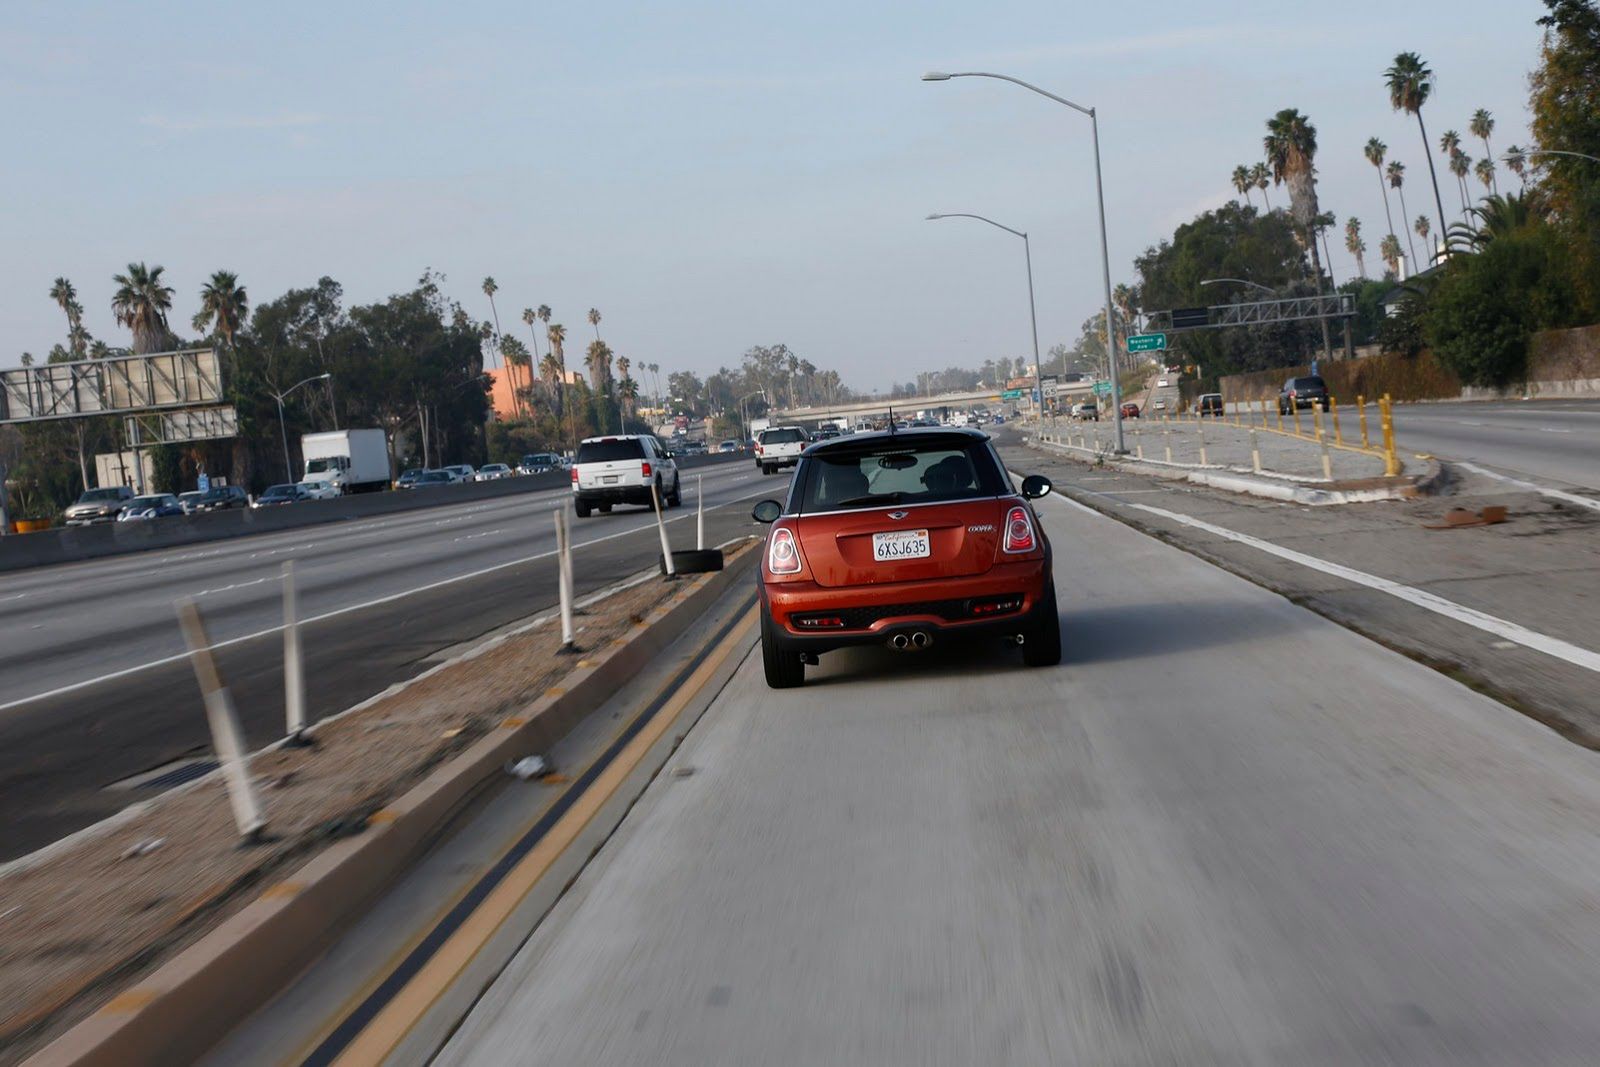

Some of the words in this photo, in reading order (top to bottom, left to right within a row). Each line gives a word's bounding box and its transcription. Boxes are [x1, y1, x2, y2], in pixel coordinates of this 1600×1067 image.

[1044, 387, 1057, 396] 65
[968, 524, 993, 532] COOPER
[877, 540, 926, 557] 6XSJ635
